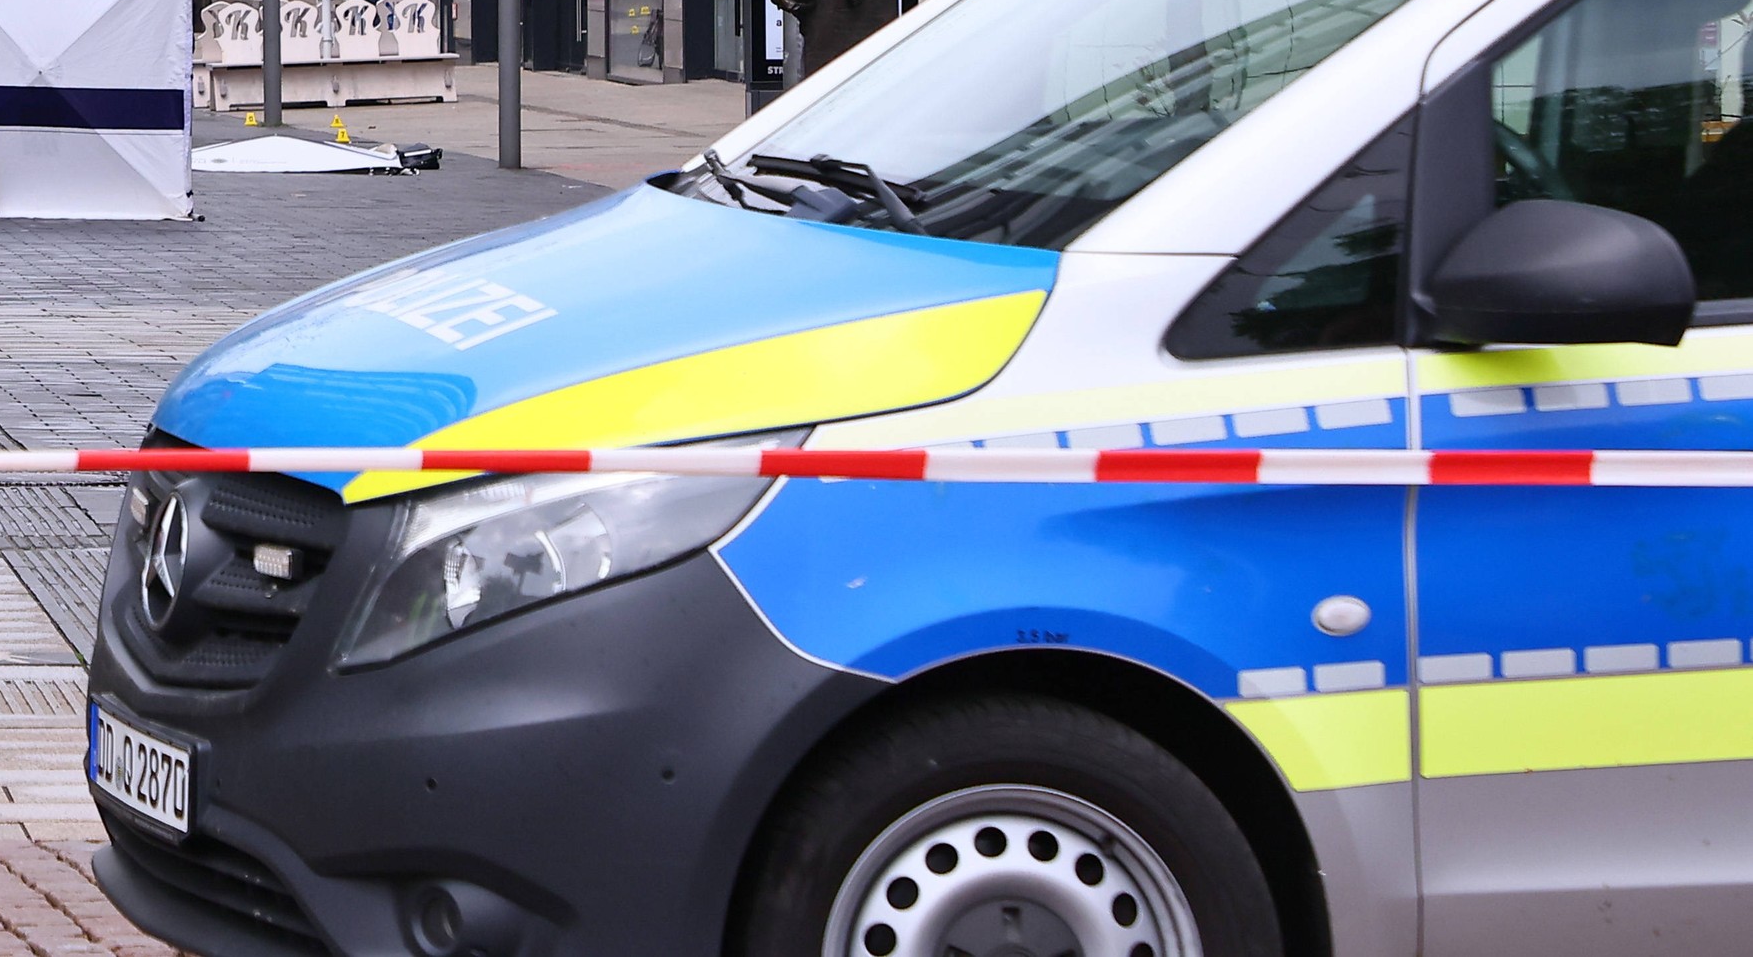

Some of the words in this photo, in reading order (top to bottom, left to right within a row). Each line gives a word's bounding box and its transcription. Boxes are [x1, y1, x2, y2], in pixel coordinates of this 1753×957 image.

[98, 718, 114, 783] DD
[123, 735, 134, 797] Q
[136, 743, 186, 821] 2870
